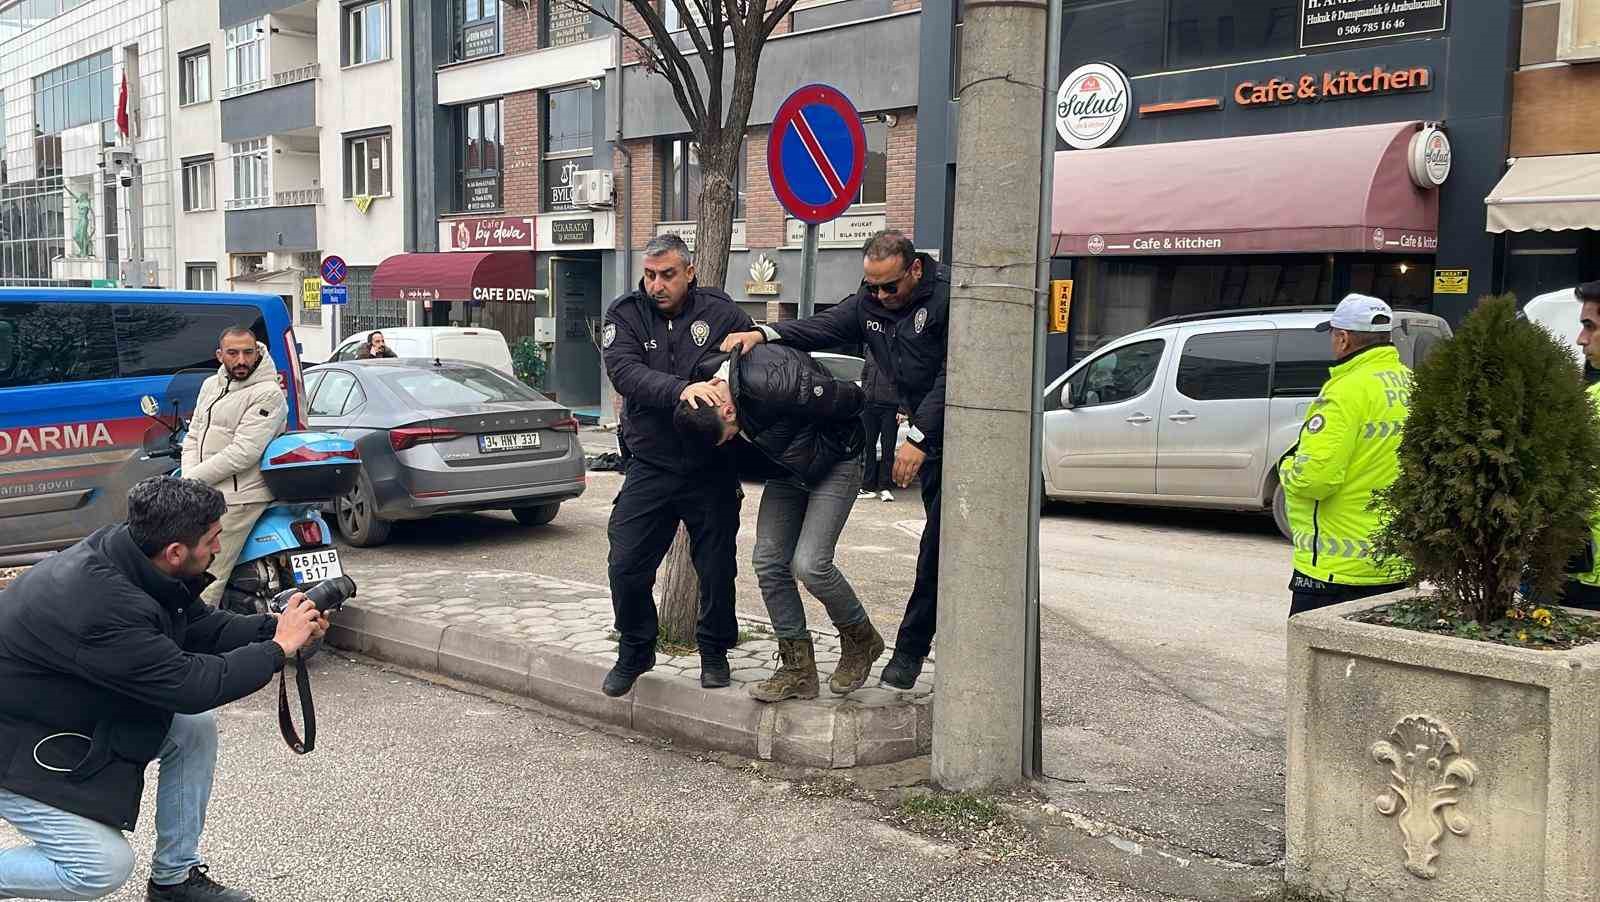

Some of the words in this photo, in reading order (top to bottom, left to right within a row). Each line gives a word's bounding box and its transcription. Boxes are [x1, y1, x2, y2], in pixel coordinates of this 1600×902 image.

[1337, 27, 1343, 36] 0
[1345, 24, 1361, 35] 506
[1362, 22, 1379, 32] 785
[1380, 20, 1392, 30] 16
[1393, 18, 1405, 28] 46
[1234, 79, 1295, 105] Cafe
[1296, 75, 1317, 98] &
[1322, 65, 1430, 97] kitchen
[1057, 89, 1124, 119] Salud
[475, 222, 490, 246] by
[493, 221, 526, 244] deva
[1400, 234, 1416, 247] Cafe
[1133, 238, 1161, 249] Cafe
[1163, 238, 1172, 248] &
[1174, 236, 1221, 248] kitchen
[472, 287, 504, 300] CAFE
[506, 288, 536, 301] DEVA
[485, 436, 498, 447] 34
[501, 433, 518, 445] HNY
[521, 432, 537, 444] 337
[293, 557, 310, 568] 26
[312, 552, 337, 564] ALB
[306, 566, 329, 580] 517
